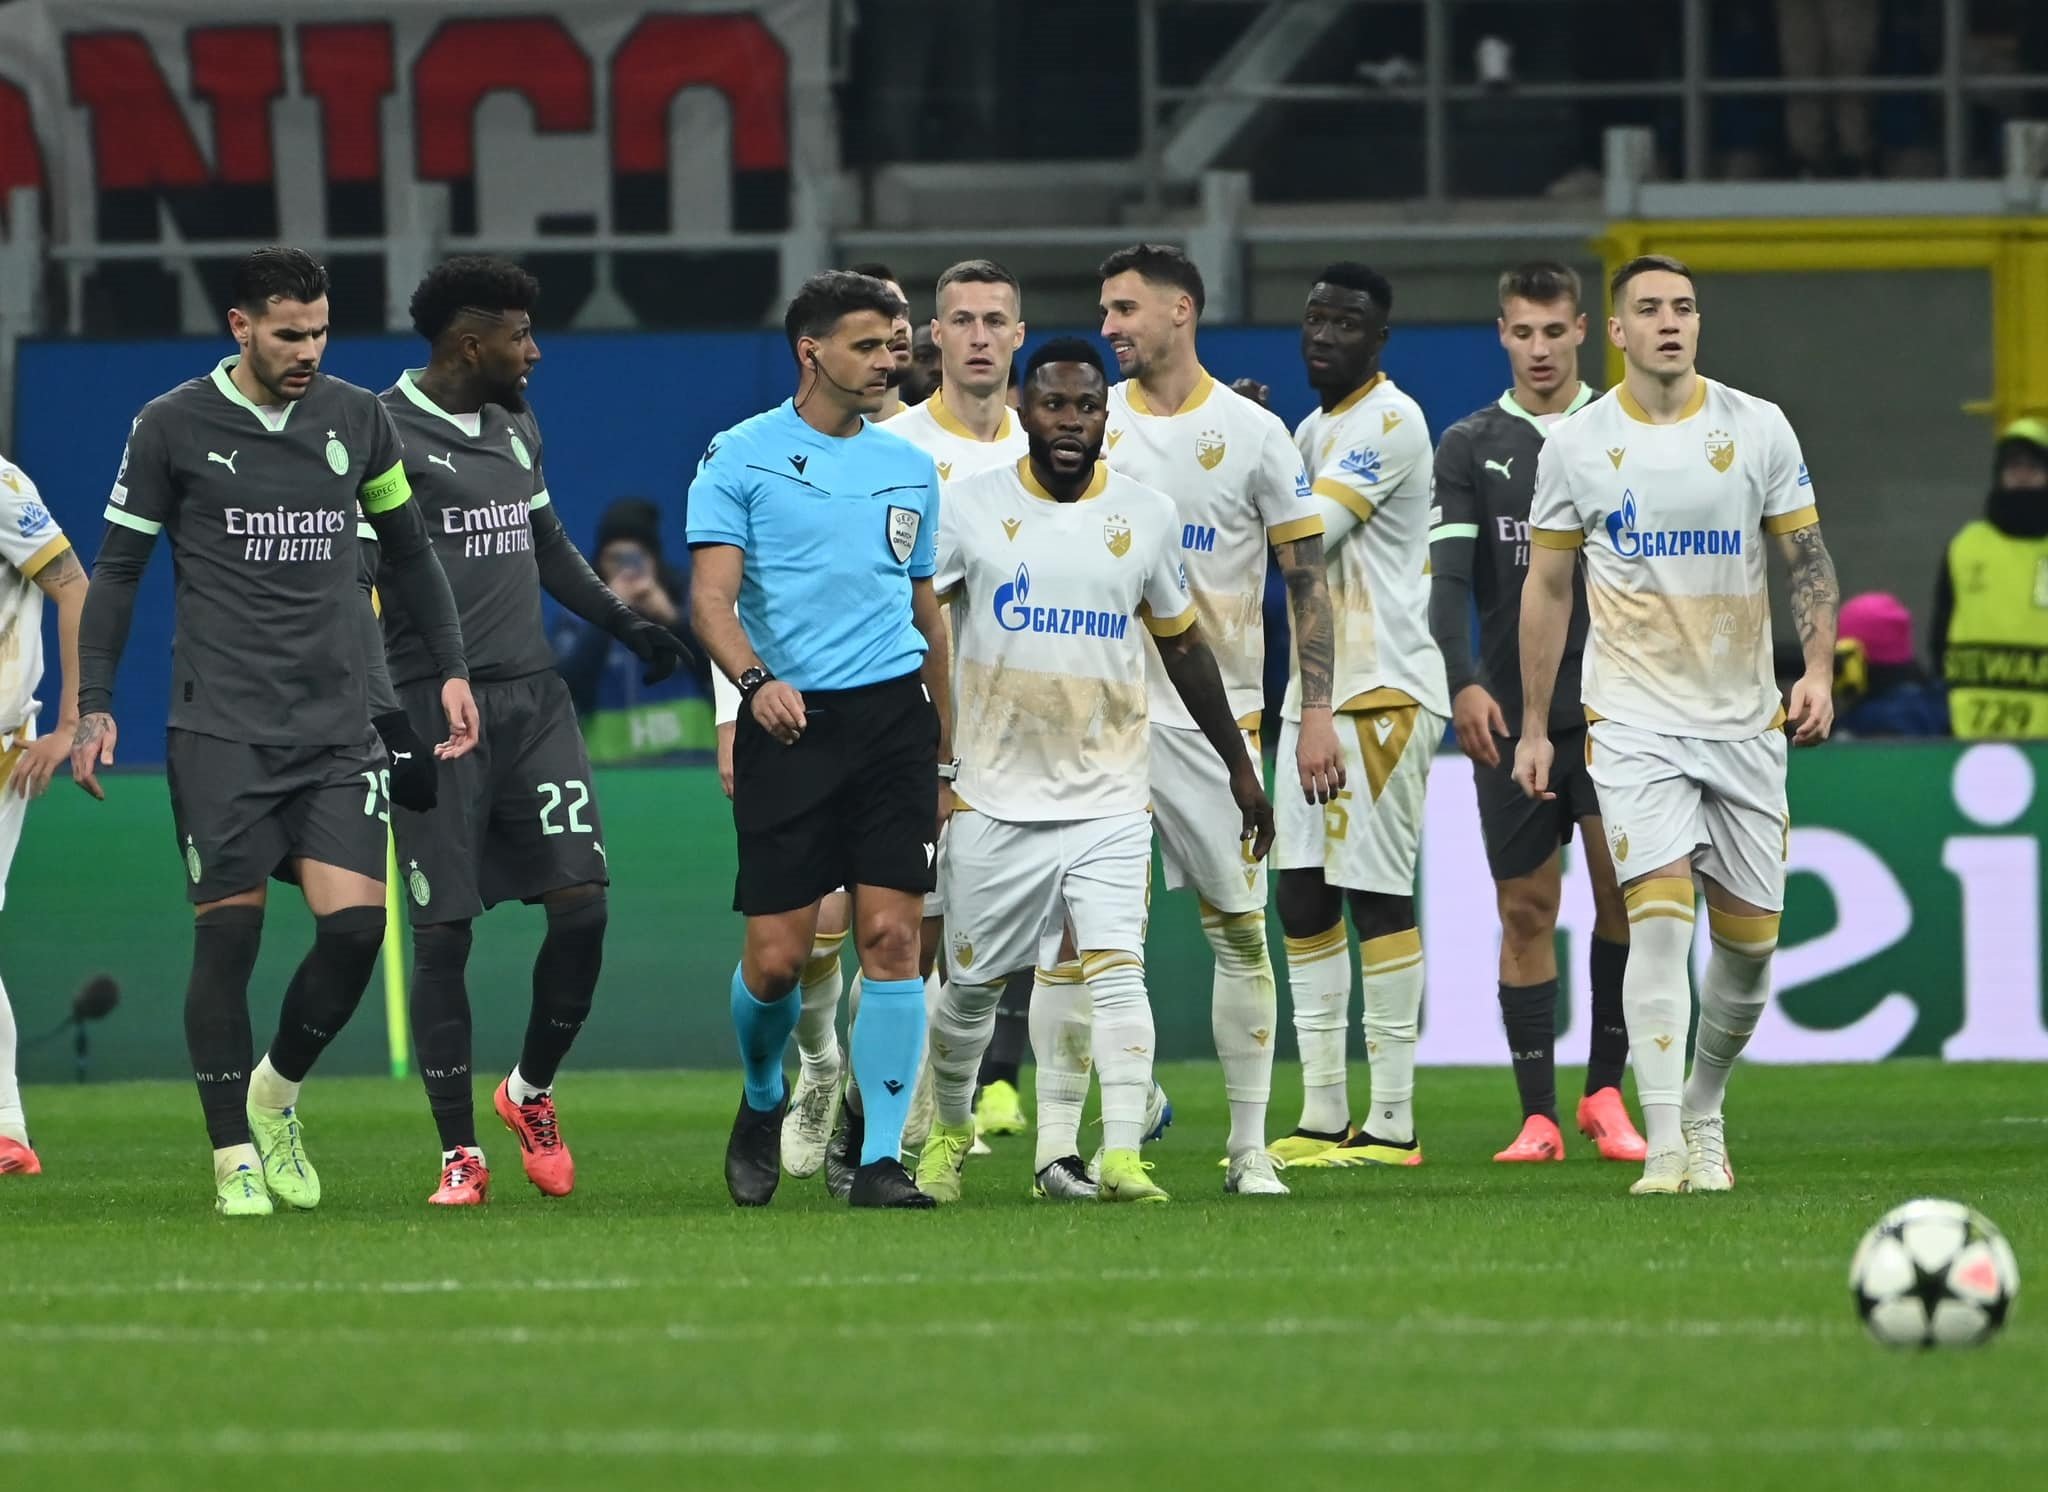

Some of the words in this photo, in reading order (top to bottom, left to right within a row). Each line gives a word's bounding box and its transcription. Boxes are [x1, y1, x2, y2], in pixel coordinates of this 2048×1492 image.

[224, 505, 345, 535] Emirates
[244, 538, 274, 560] FLY
[278, 538, 332, 561] BETTER
[465, 533, 492, 558] FLY
[1642, 530, 1742, 557] GAZPROM
[1032, 607, 1128, 640] GAZPROM
[537, 780, 593, 836] 22
[196, 1071, 242, 1082] MILAN
[425, 1064, 467, 1079] MILAN
